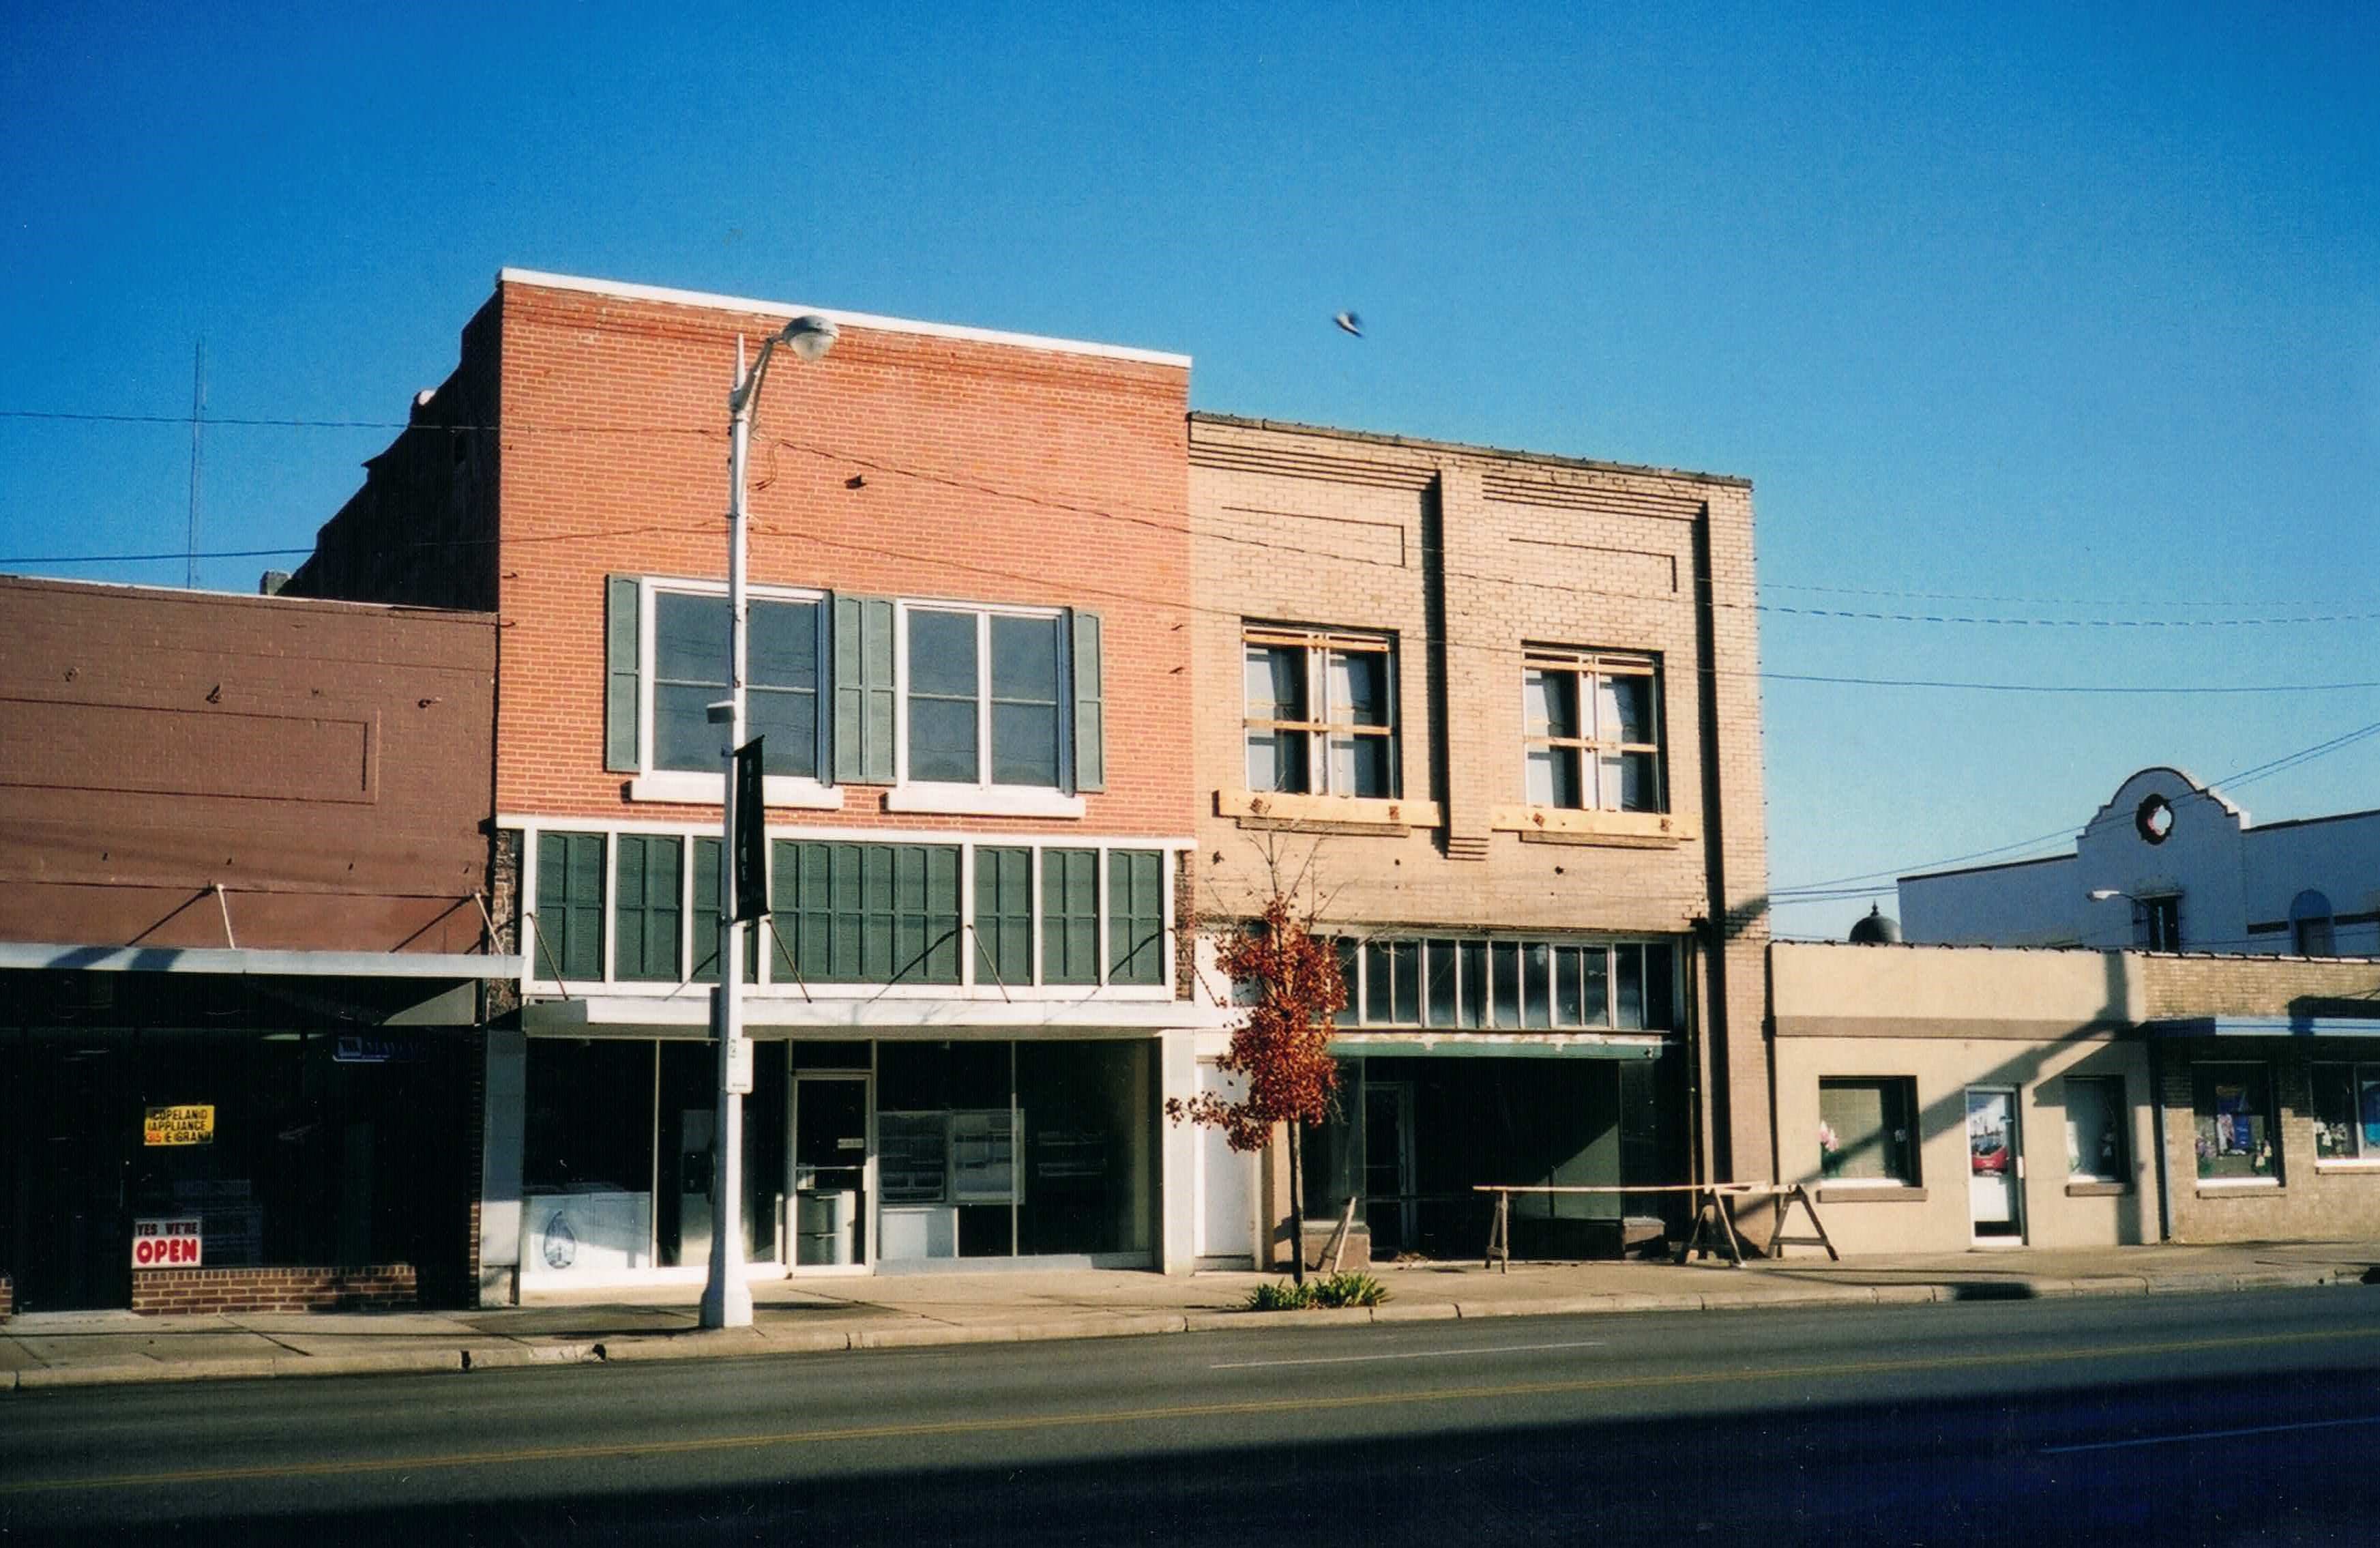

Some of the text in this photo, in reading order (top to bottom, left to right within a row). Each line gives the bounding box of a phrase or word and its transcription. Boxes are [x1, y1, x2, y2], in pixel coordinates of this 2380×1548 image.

[152, 1109, 208, 1120] COPELAND
[149, 1120, 207, 1131] APPLIANCE
[136, 1222, 198, 1236] YES WE'RE
[136, 1238, 197, 1265] OPEN
